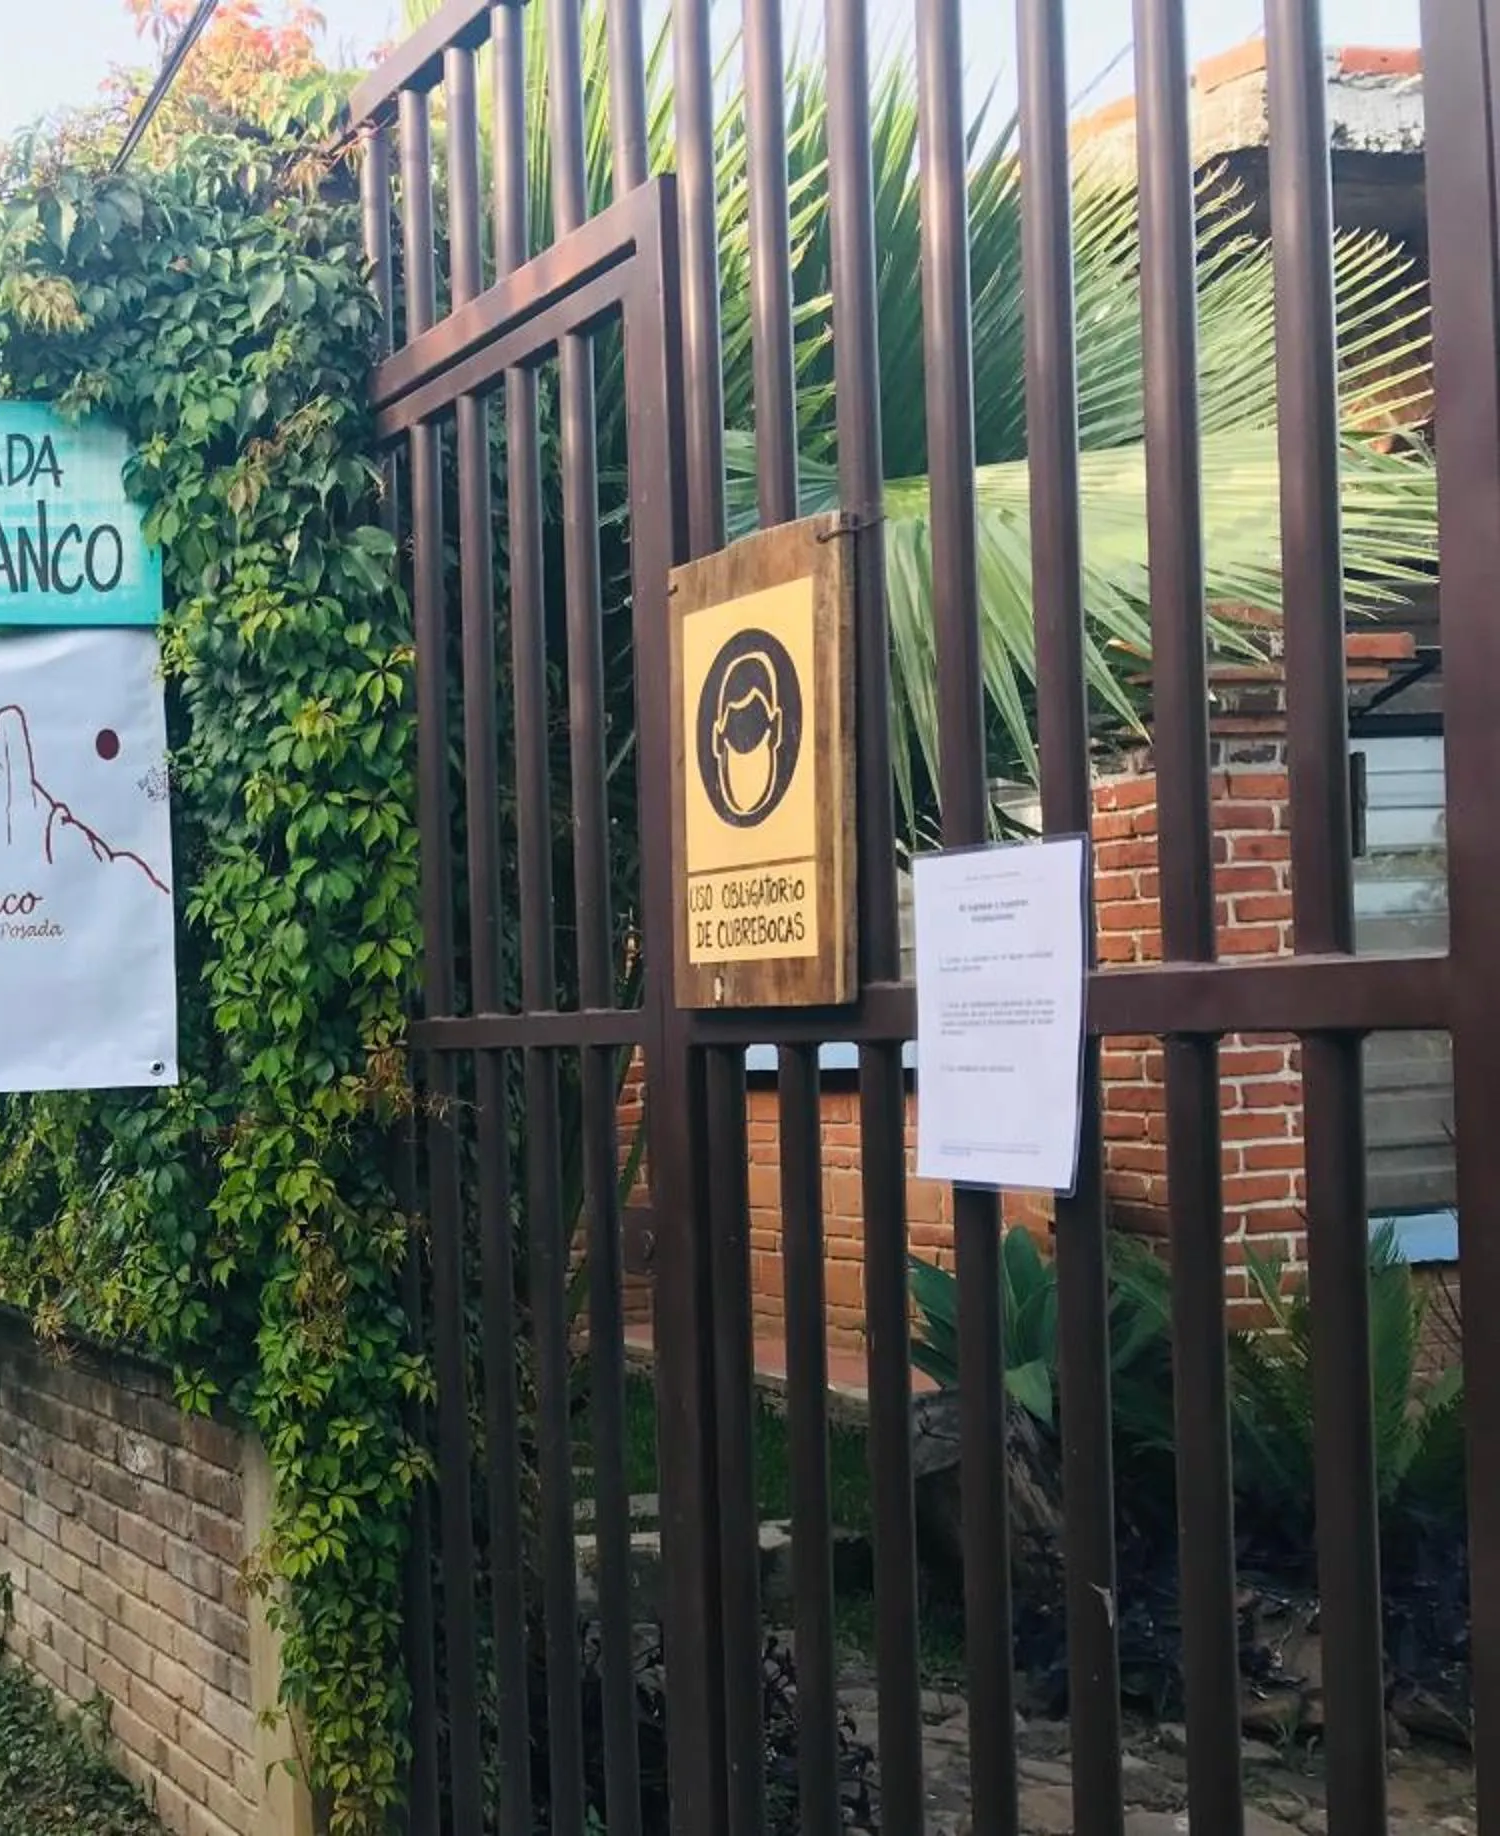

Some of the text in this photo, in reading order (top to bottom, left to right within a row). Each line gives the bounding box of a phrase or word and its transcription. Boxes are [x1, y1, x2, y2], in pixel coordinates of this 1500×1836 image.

[689, 884, 713, 912] USO
[0, 920, 64, 938] Posada
[696, 912, 805, 948] DE CUBREBOCAS
